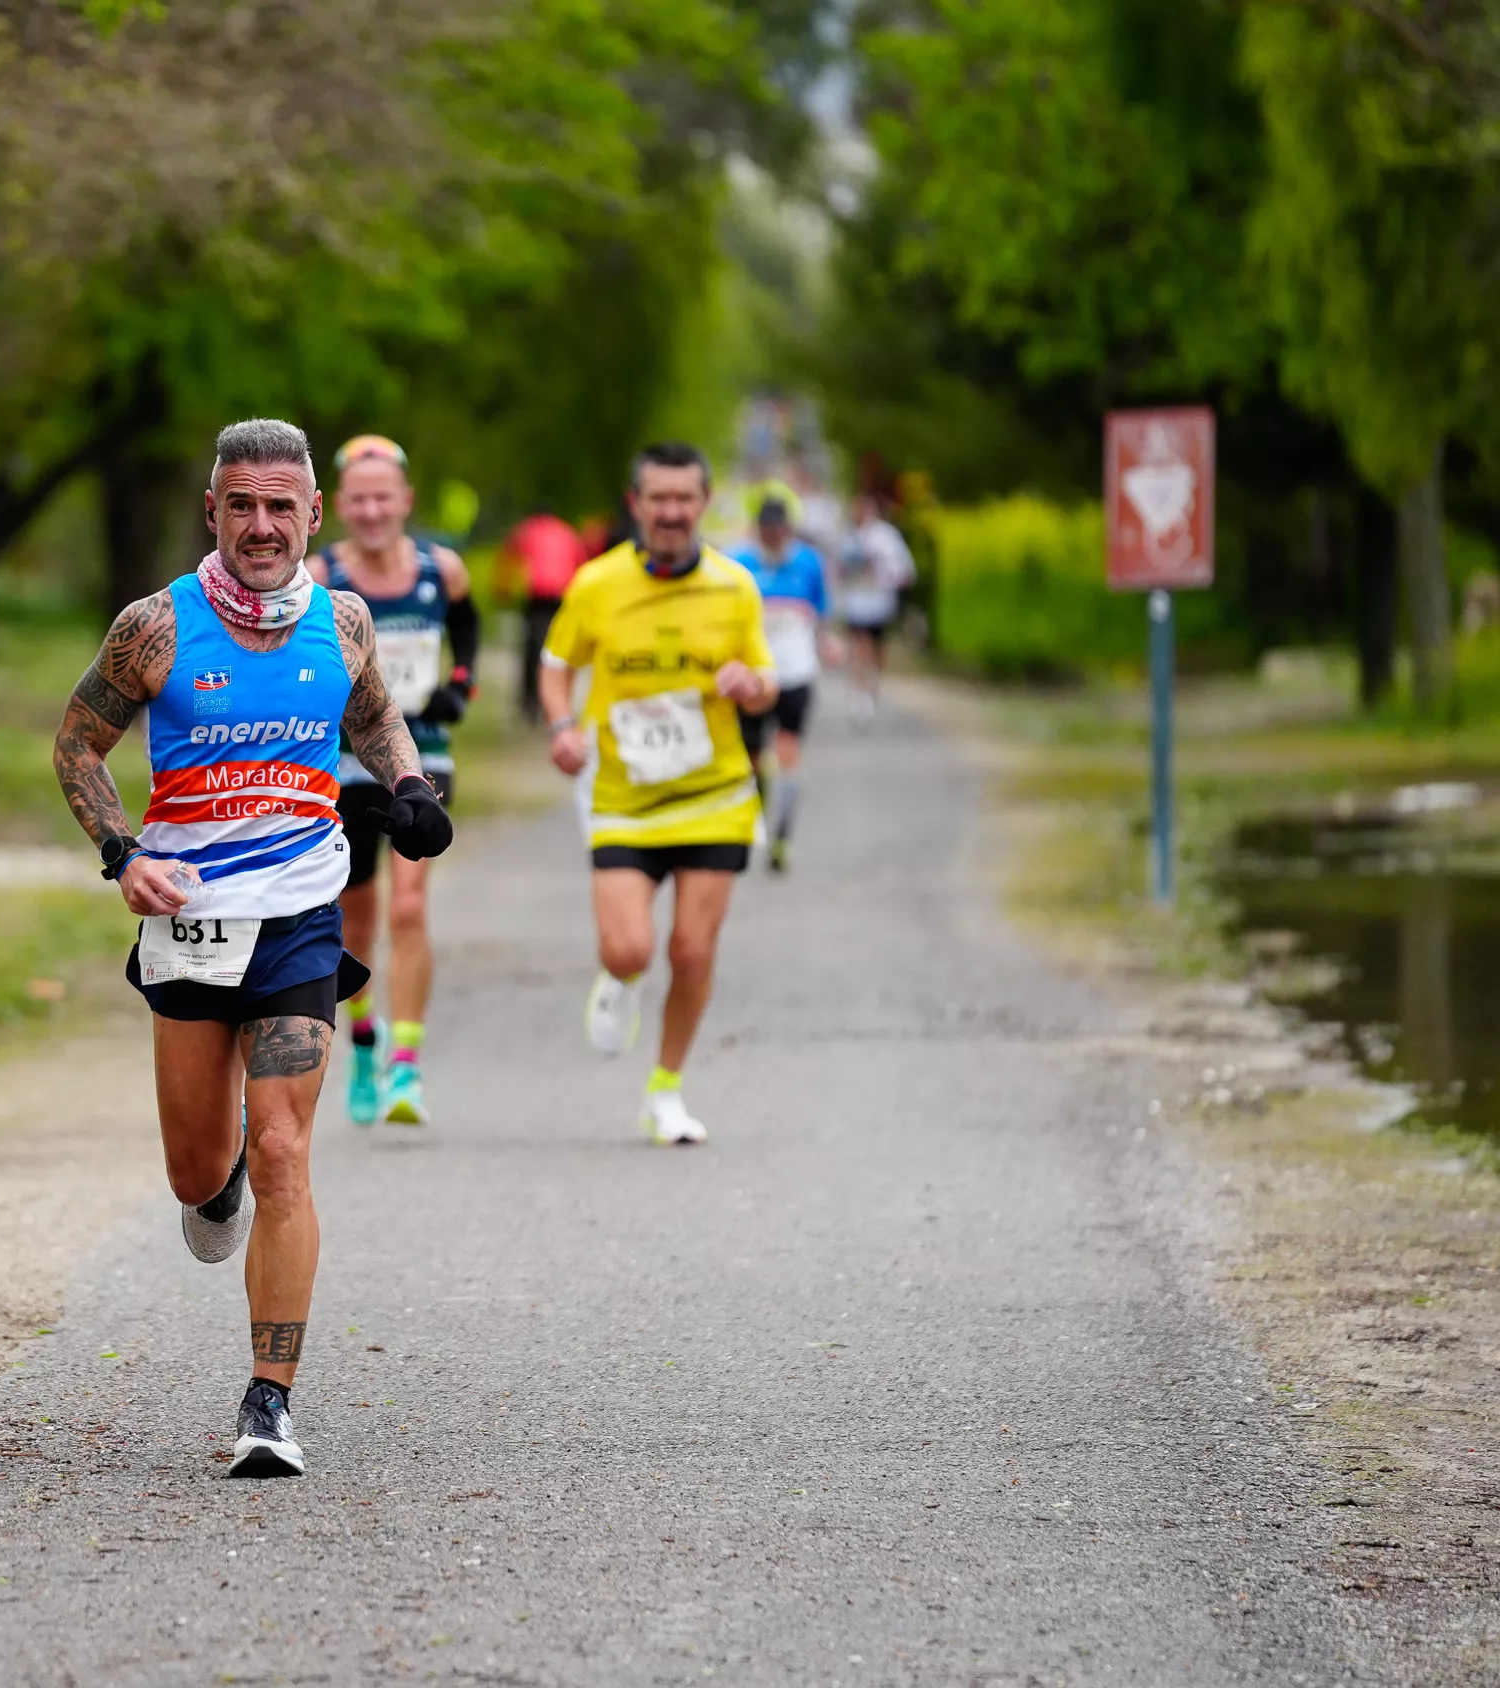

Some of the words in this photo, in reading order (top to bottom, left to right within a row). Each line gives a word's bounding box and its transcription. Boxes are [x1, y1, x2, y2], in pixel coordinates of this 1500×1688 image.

[190, 717, 329, 745] enerplus
[206, 764, 309, 791] Maratón
[212, 800, 298, 818] Lucena
[171, 916, 228, 944] 631
